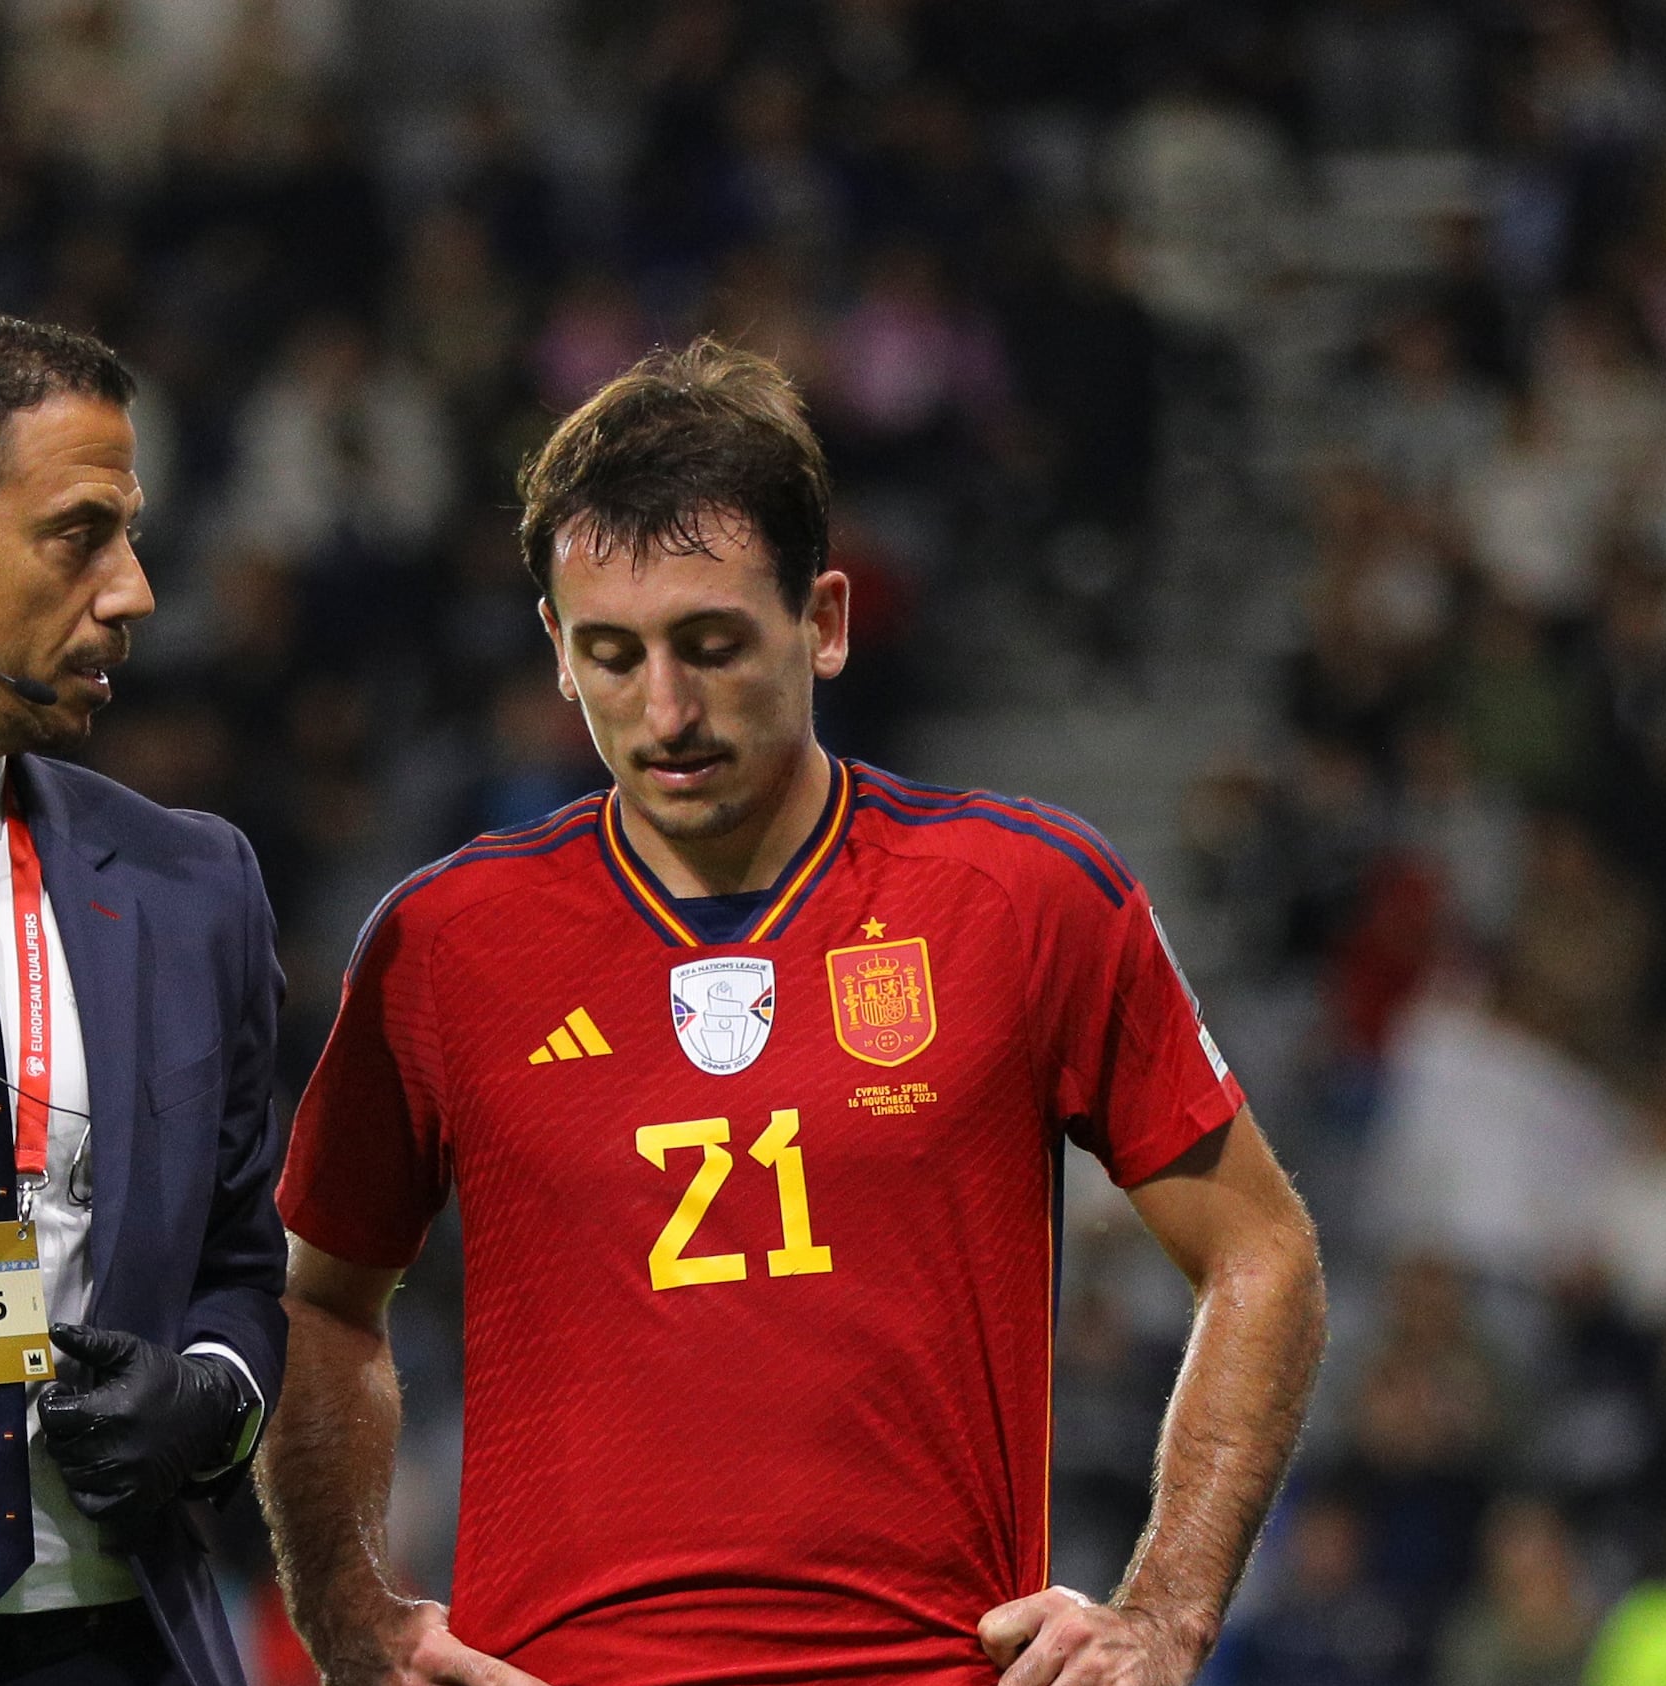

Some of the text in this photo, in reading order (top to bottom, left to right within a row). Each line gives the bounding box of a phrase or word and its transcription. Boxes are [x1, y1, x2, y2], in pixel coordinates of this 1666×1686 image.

[676, 961, 768, 979] UEFA NATIONS LEAGUE
[25, 912, 43, 1052] EUROPEAN QUALIFIERS
[700, 1058, 732, 1071] WINNER
[855, 1085, 891, 1098] CYPRUS
[900, 1081, 929, 1094] SPAIN
[848, 1091, 938, 1109] 16 NOVEMBER 2023
[871, 1103, 917, 1116] LIMASSOL
[635, 1107, 833, 1292] 21
